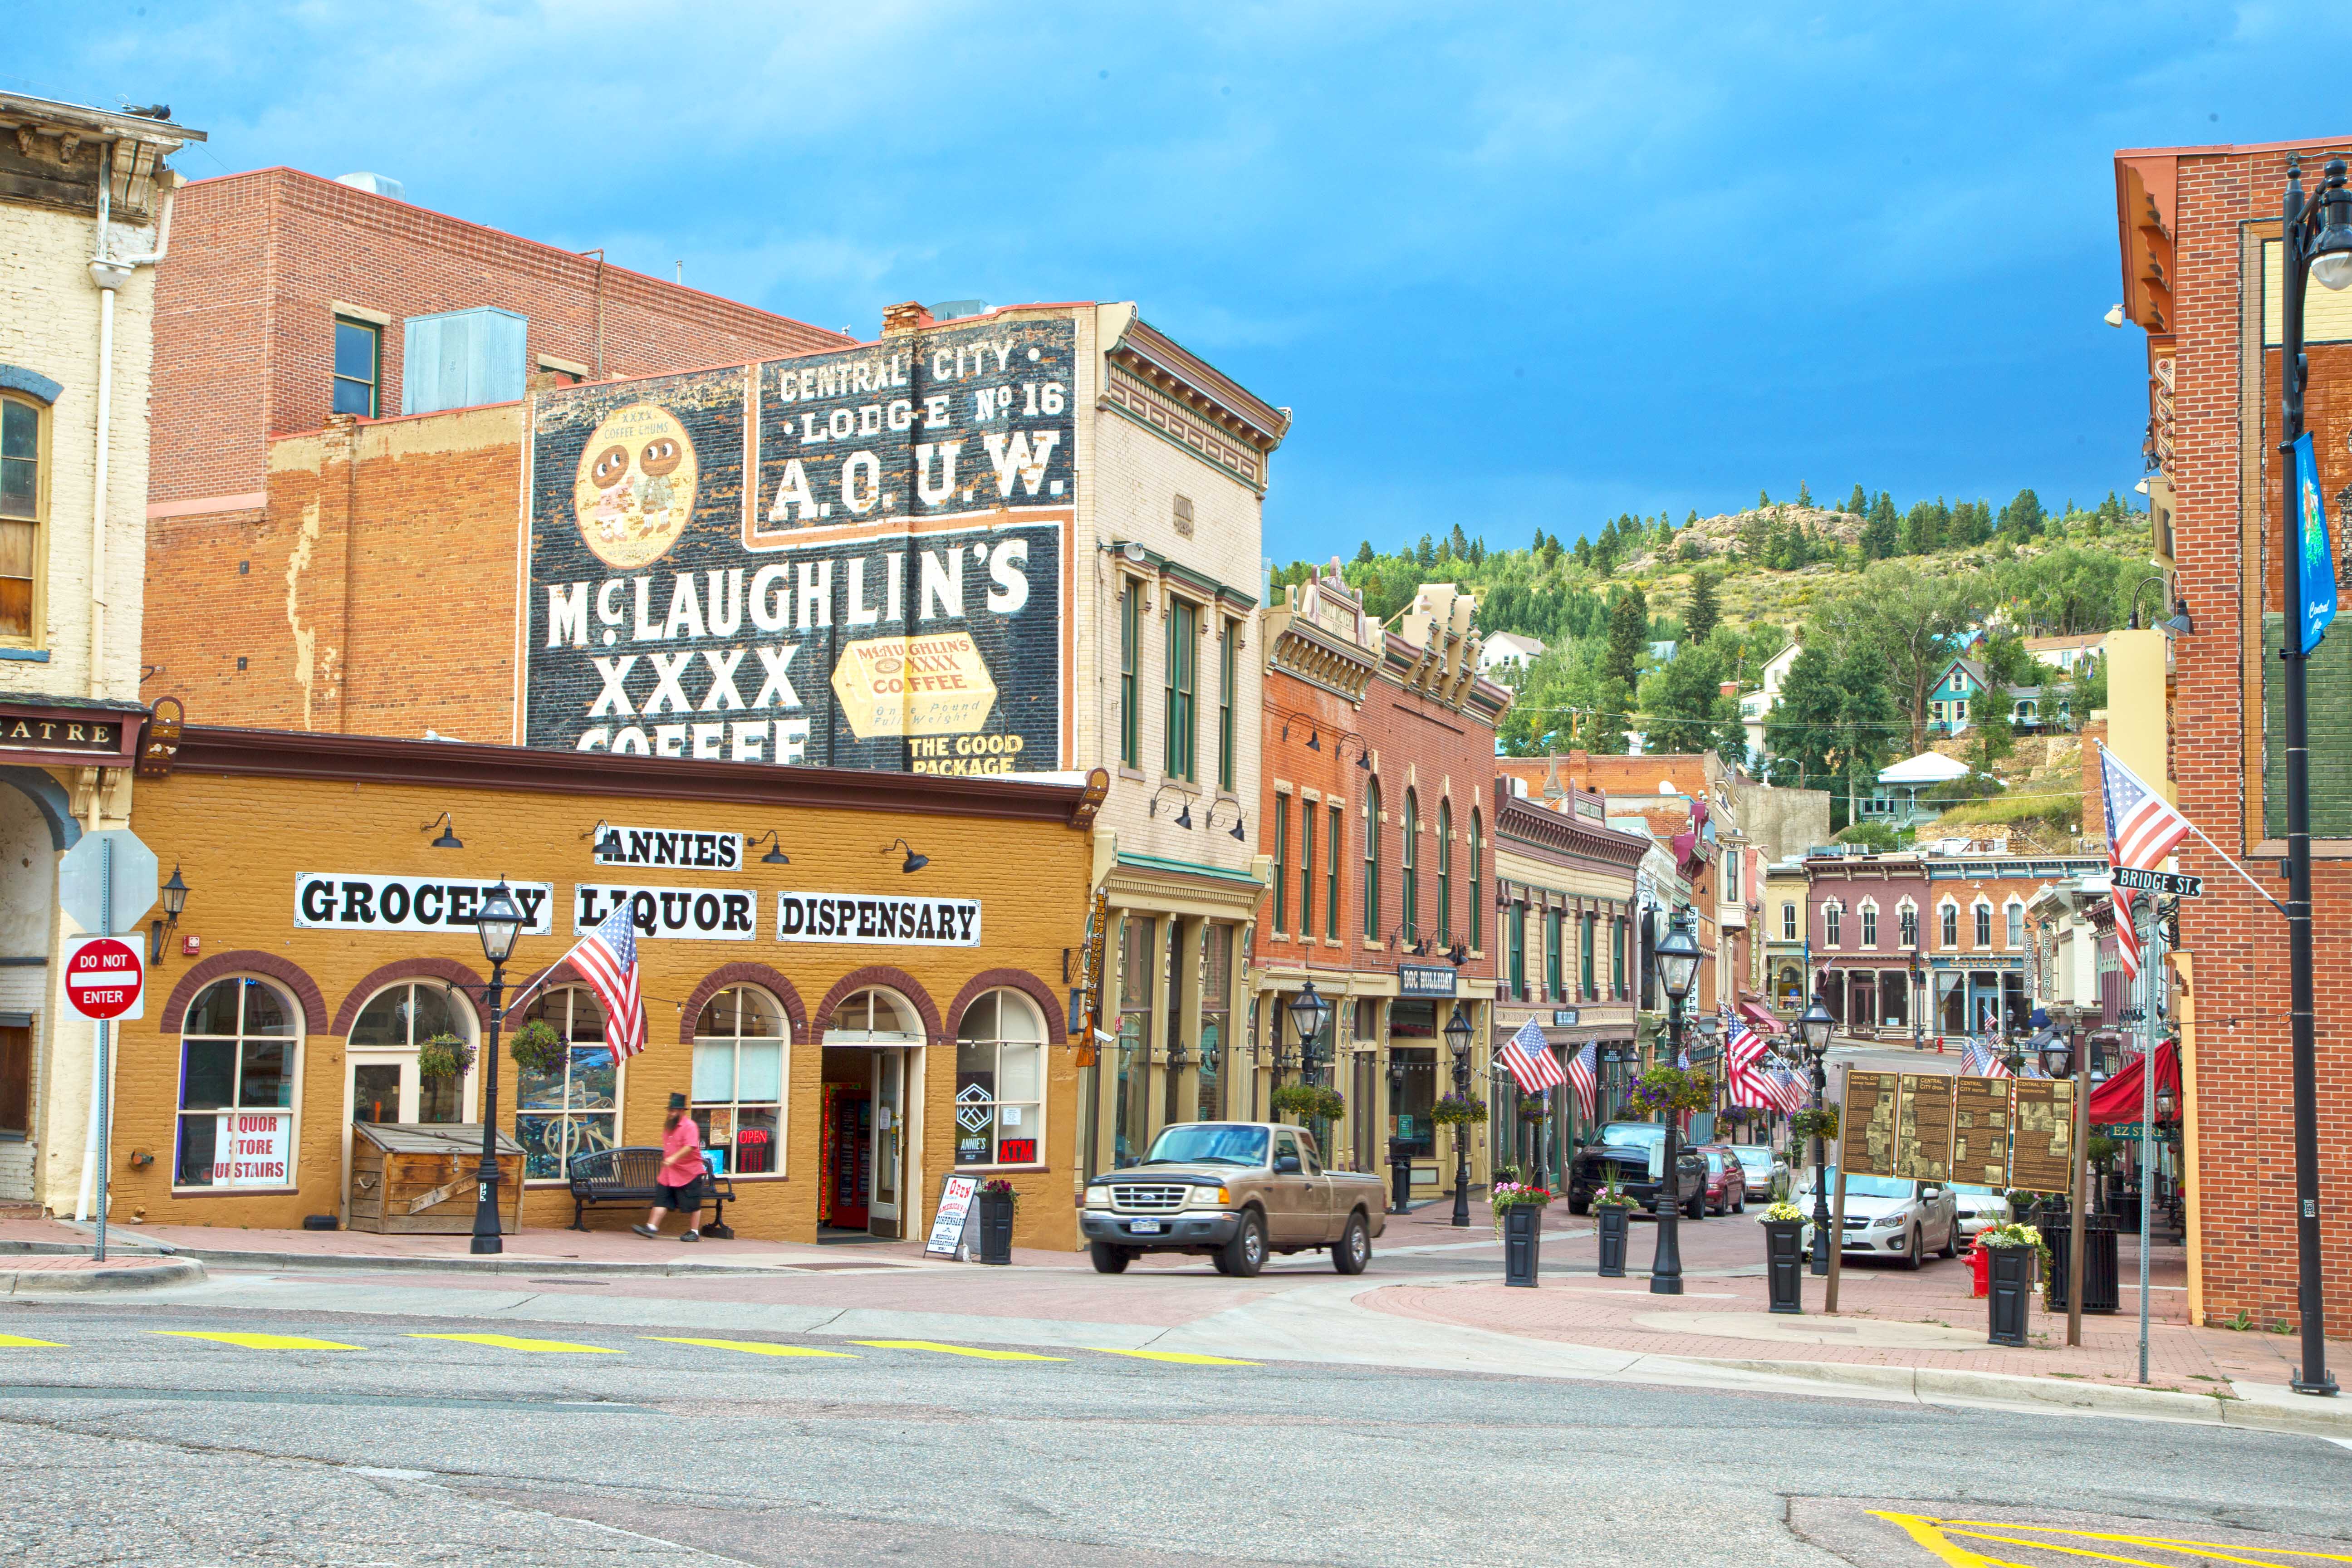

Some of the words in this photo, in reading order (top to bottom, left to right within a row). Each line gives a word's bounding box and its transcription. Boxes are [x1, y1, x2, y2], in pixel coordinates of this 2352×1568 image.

[781, 355, 906, 402] CENTRAL
[933, 340, 1015, 381] CITY
[622, 410, 652, 422] XXXX
[801, 395, 950, 444] LODGE
[1023, 382, 1065, 416] 16
[604, 427, 633, 439] COFFEE
[639, 422, 668, 435] CHUMS
[906, 655, 960, 672] XXXX
[587, 645, 803, 717] XXXX
[873, 675, 967, 694] COFFEE
[931, 701, 980, 712] Pound
[874, 716, 902, 726] Full
[912, 713, 968, 724] Weight
[0, 722, 109, 743] ATRE
[909, 737, 949, 756] THE
[956, 735, 1023, 755] GOOD
[913, 757, 1015, 775] PACKAGE
[603, 829, 736, 868] ANNIES
[2120, 870, 2170, 891] BRIDGE
[2176, 877, 2195, 894] ST.
[783, 898, 975, 940] DISPENSARY
[1688, 909, 1697, 947] SWE
[80, 956, 97, 968] DO
[103, 954, 127, 967] NOT
[2043, 928, 2051, 999] CENTURY
[1404, 970, 1418, 988] DOC
[1420, 971, 1452, 990] HOLLIDAY
[83, 990, 123, 1004] ENTER
[227, 1116, 277, 1133] LQUOR
[2113, 1126, 2129, 1135] EZ
[738, 1130, 767, 1143] OPEN
[960, 1138, 986, 1150] ANNIE'S
[999, 1140, 1034, 1162] ATM
[215, 1161, 284, 1178] UPSTAIRS
[949, 1179, 971, 1198] OPEN
